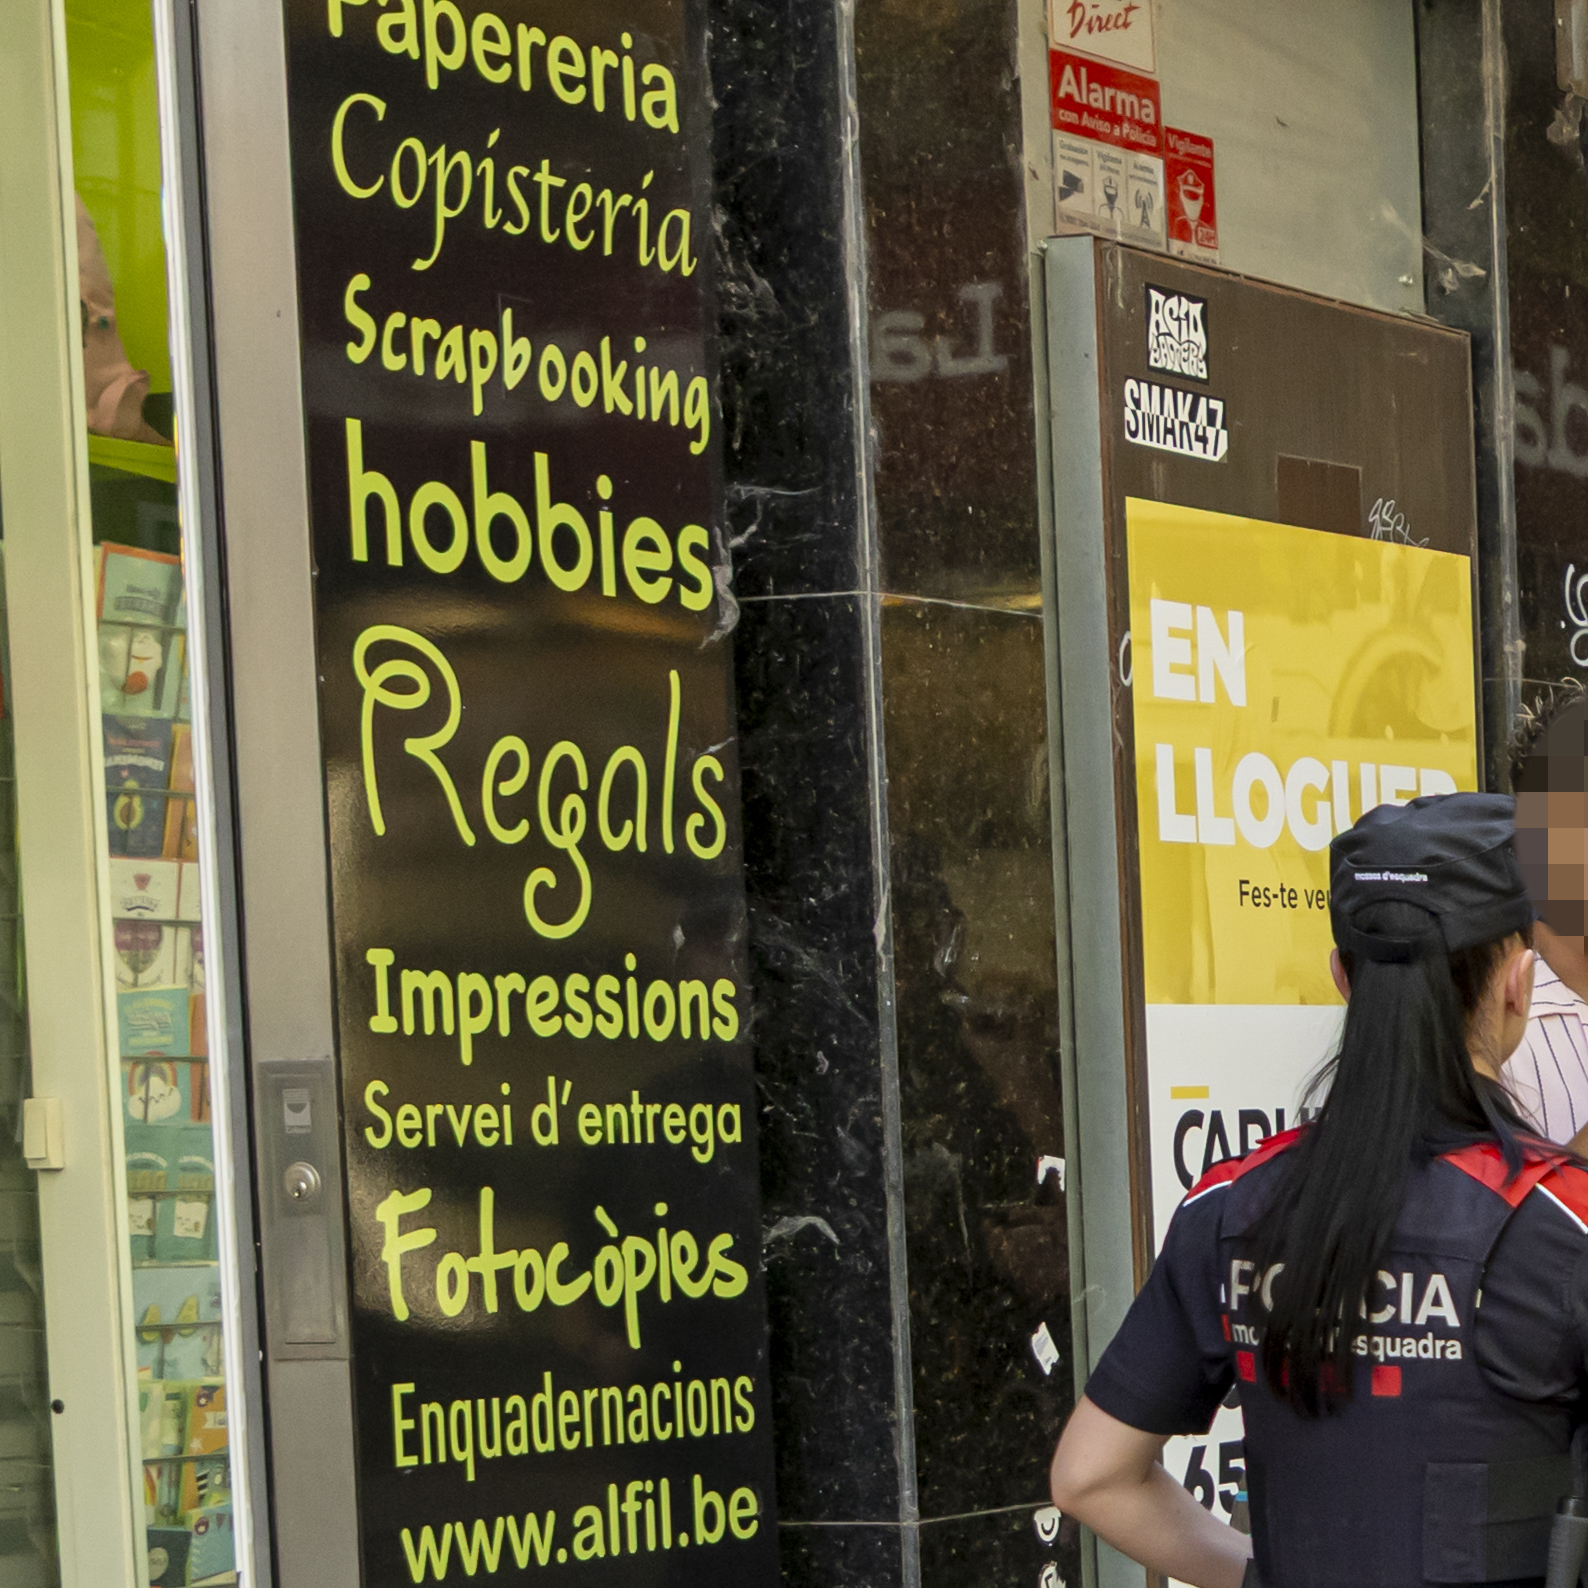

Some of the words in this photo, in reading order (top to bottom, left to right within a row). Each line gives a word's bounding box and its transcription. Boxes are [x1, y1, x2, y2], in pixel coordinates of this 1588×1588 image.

[1058, 64, 1156, 124] Alarma
[1059, 107, 1080, 124] con
[1081, 111, 1112, 134] Aviso
[1113, 124, 1121, 136] a
[332, 93, 697, 276] Copisteria
[345, 274, 710, 454] Scrapbooking
[1125, 378, 1225, 457] SMAK47
[346, 418, 713, 611] hobbies
[1150, 598, 1247, 707] EN
[353, 625, 726, 939] Regals
[1238, 879, 1299, 910] Fes-te
[366, 947, 740, 1065] Impressions
[364, 1074, 513, 1149] Servei
[530, 1075, 742, 1163] d'entrega
[375, 1187, 749, 1349] Fotocòpies
[392, 1361, 755, 1481] Enquadernacions
[401, 1475, 759, 1583] www.alfil.be
